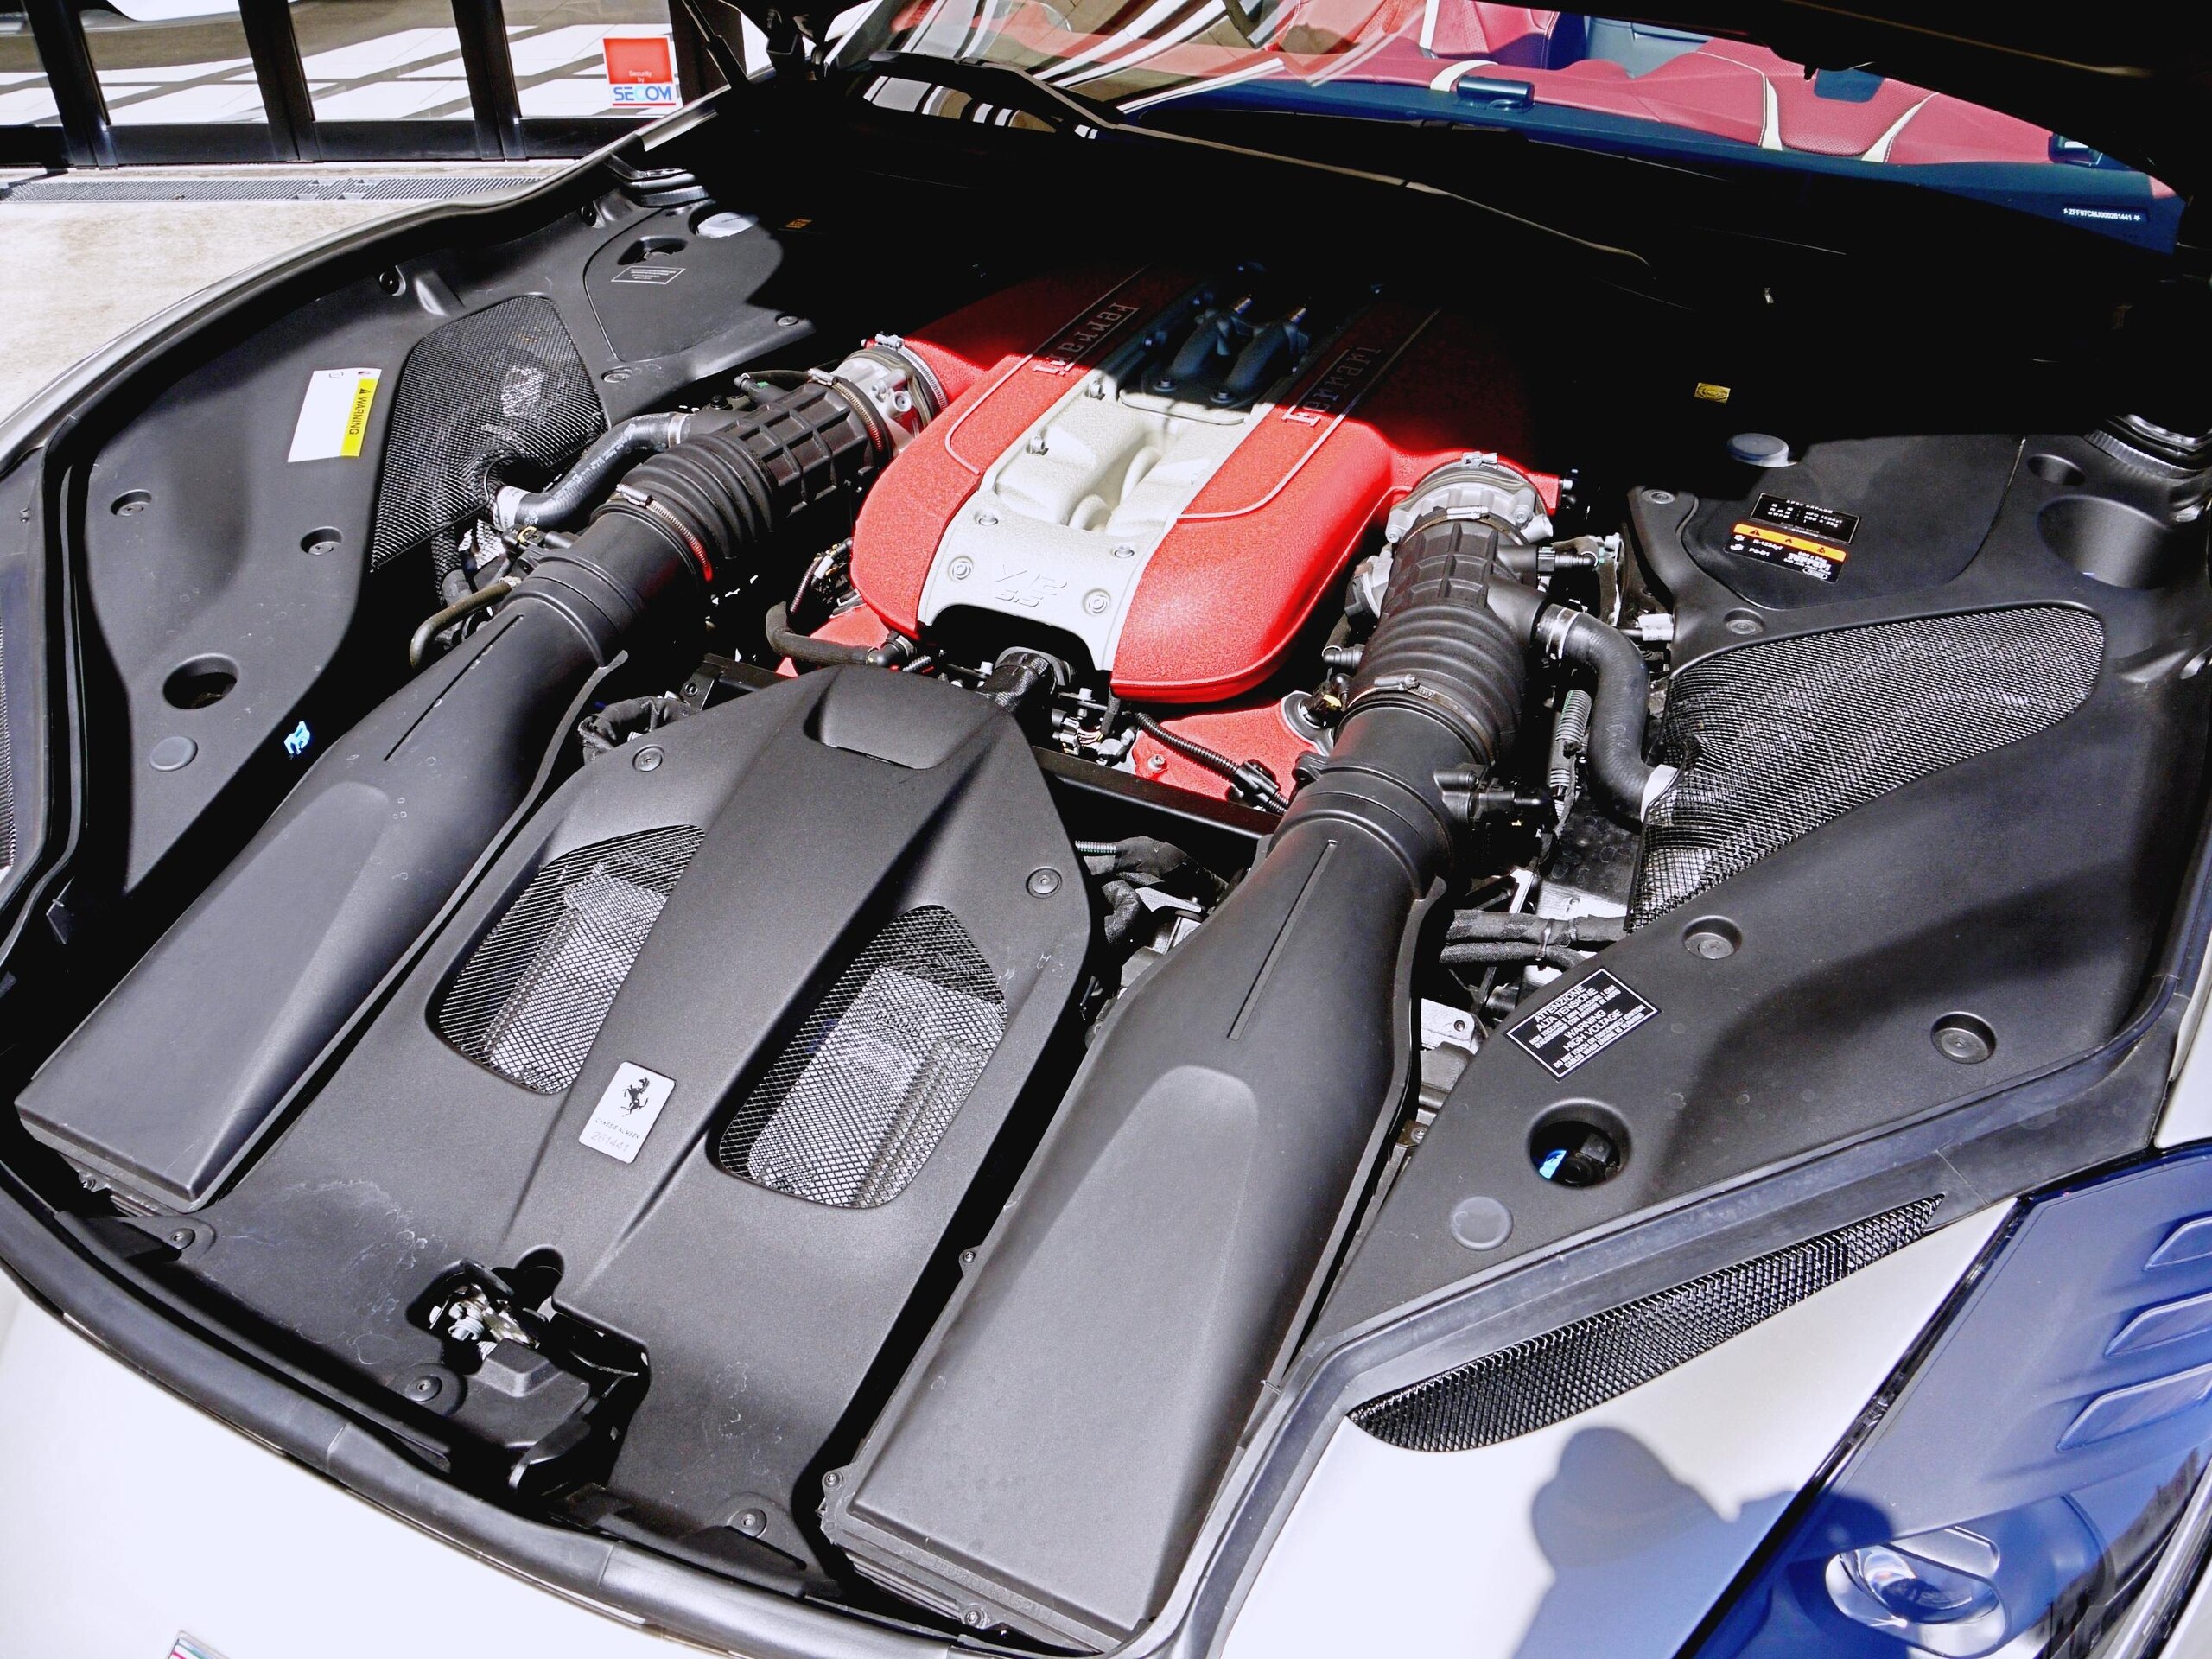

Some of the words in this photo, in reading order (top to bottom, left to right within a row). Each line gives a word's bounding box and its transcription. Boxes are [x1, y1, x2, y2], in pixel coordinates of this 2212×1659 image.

[628, 69, 652, 78] Security
[613, 86, 672, 101] SECOM
[1032, 302, 1141, 377] Ferrari
[1281, 346, 1382, 428] Ferrari
[349, 397, 368, 435] WARNING
[1532, 985, 1586, 1022] ATTENZIONE
[1534, 1014, 1557, 1031] ALTA
[1554, 987, 1599, 1017] TENSIONE
[1562, 1033, 1587, 1051] HIGH
[1583, 1008, 1623, 1036] VOLTAGE
[1563, 1008, 1607, 1039] WARNING
[1552, 1059, 1564, 1068] DO
[1560, 1052, 1574, 1063] NOT
[1571, 1041, 1590, 1055] TOUCH
[591, 1131, 630, 1153] 261441
